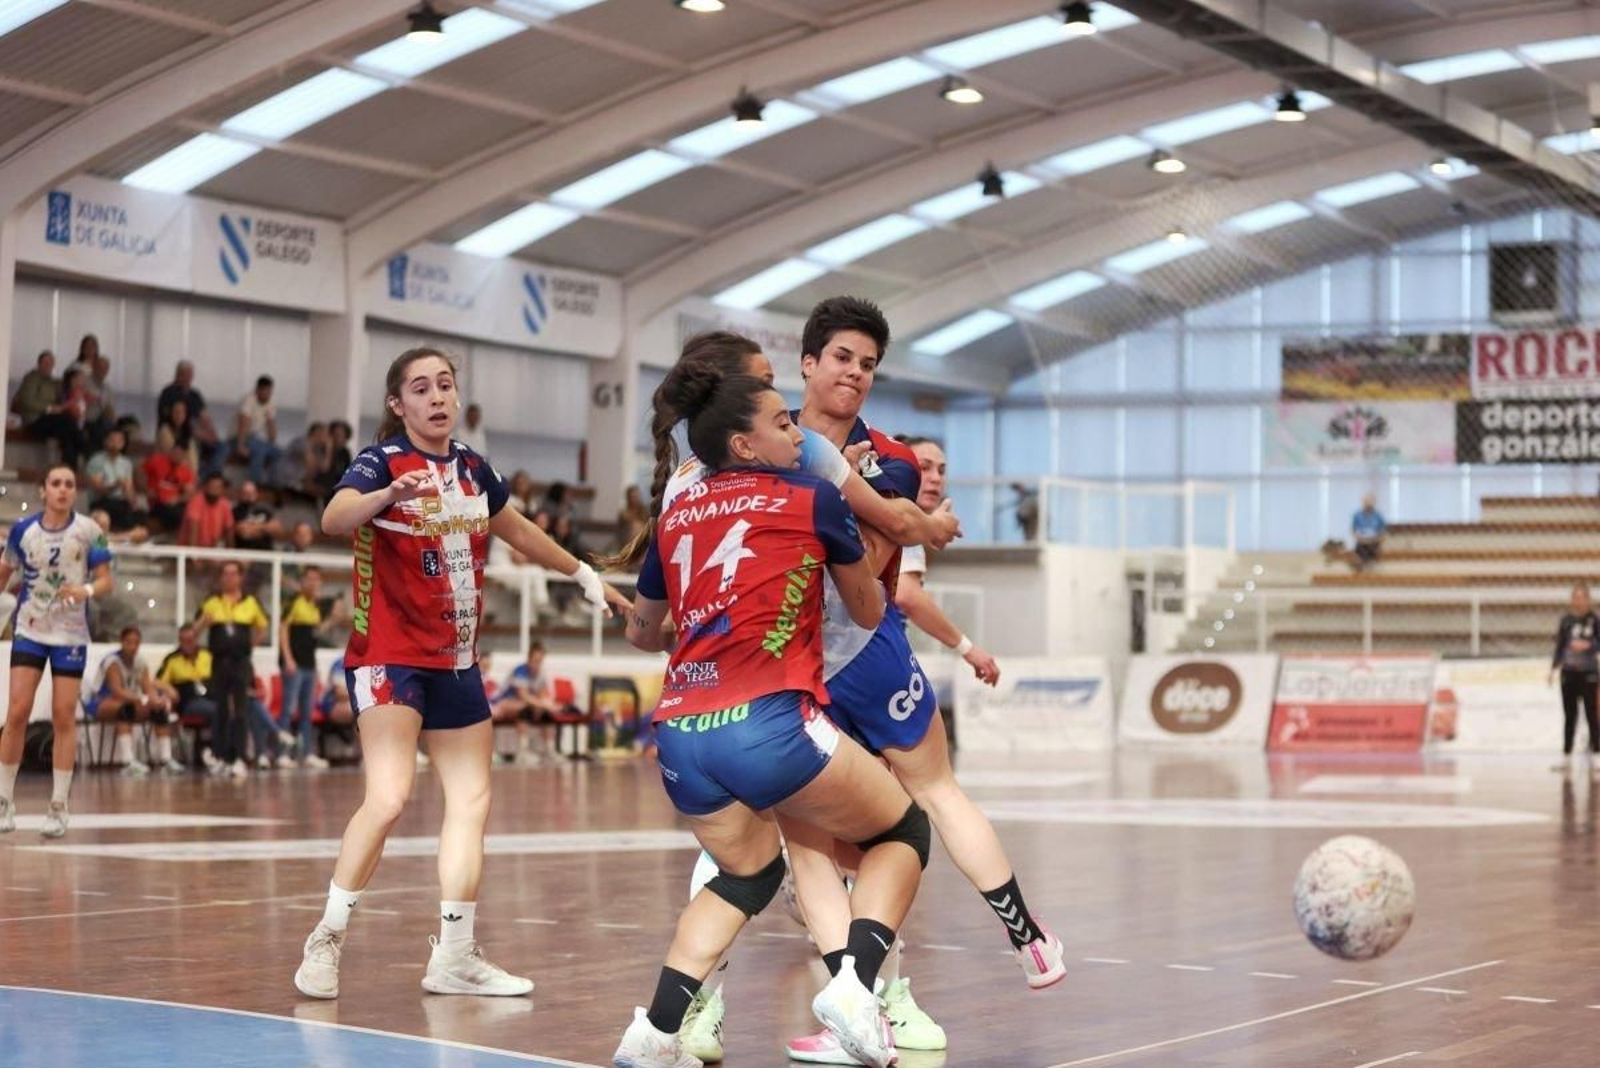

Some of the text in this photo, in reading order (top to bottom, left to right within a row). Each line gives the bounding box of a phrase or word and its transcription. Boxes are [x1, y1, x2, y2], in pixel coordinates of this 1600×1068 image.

[77, 201, 128, 227] XUNTA
[76, 223, 157, 256] DE GALICIA
[256, 220, 317, 247] DEPORTE
[256, 241, 311, 266] GALEGO
[592, 382, 624, 407] G1
[48, 547, 61, 567] 2
[669, 519, 758, 612] 14
[888, 672, 924, 721] GO
